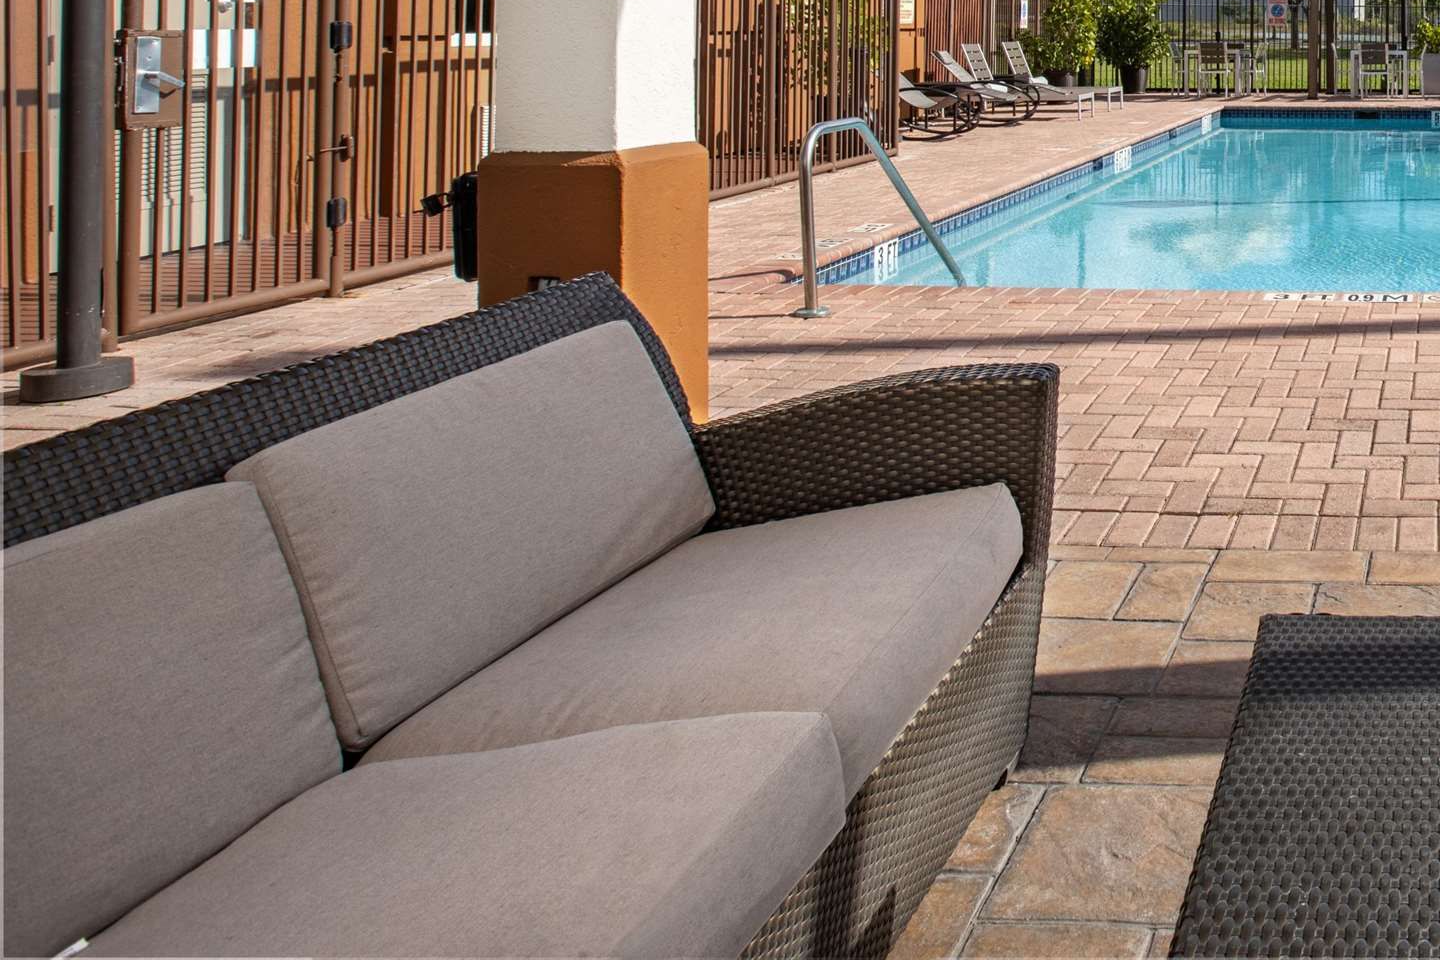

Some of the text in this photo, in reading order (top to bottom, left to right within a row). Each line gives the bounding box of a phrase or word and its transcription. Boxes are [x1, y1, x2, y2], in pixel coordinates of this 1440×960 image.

[878, 240, 897, 265] 3 FT
[1347, 294, 1375, 302] 0.9
[1382, 294, 1409, 302] M
